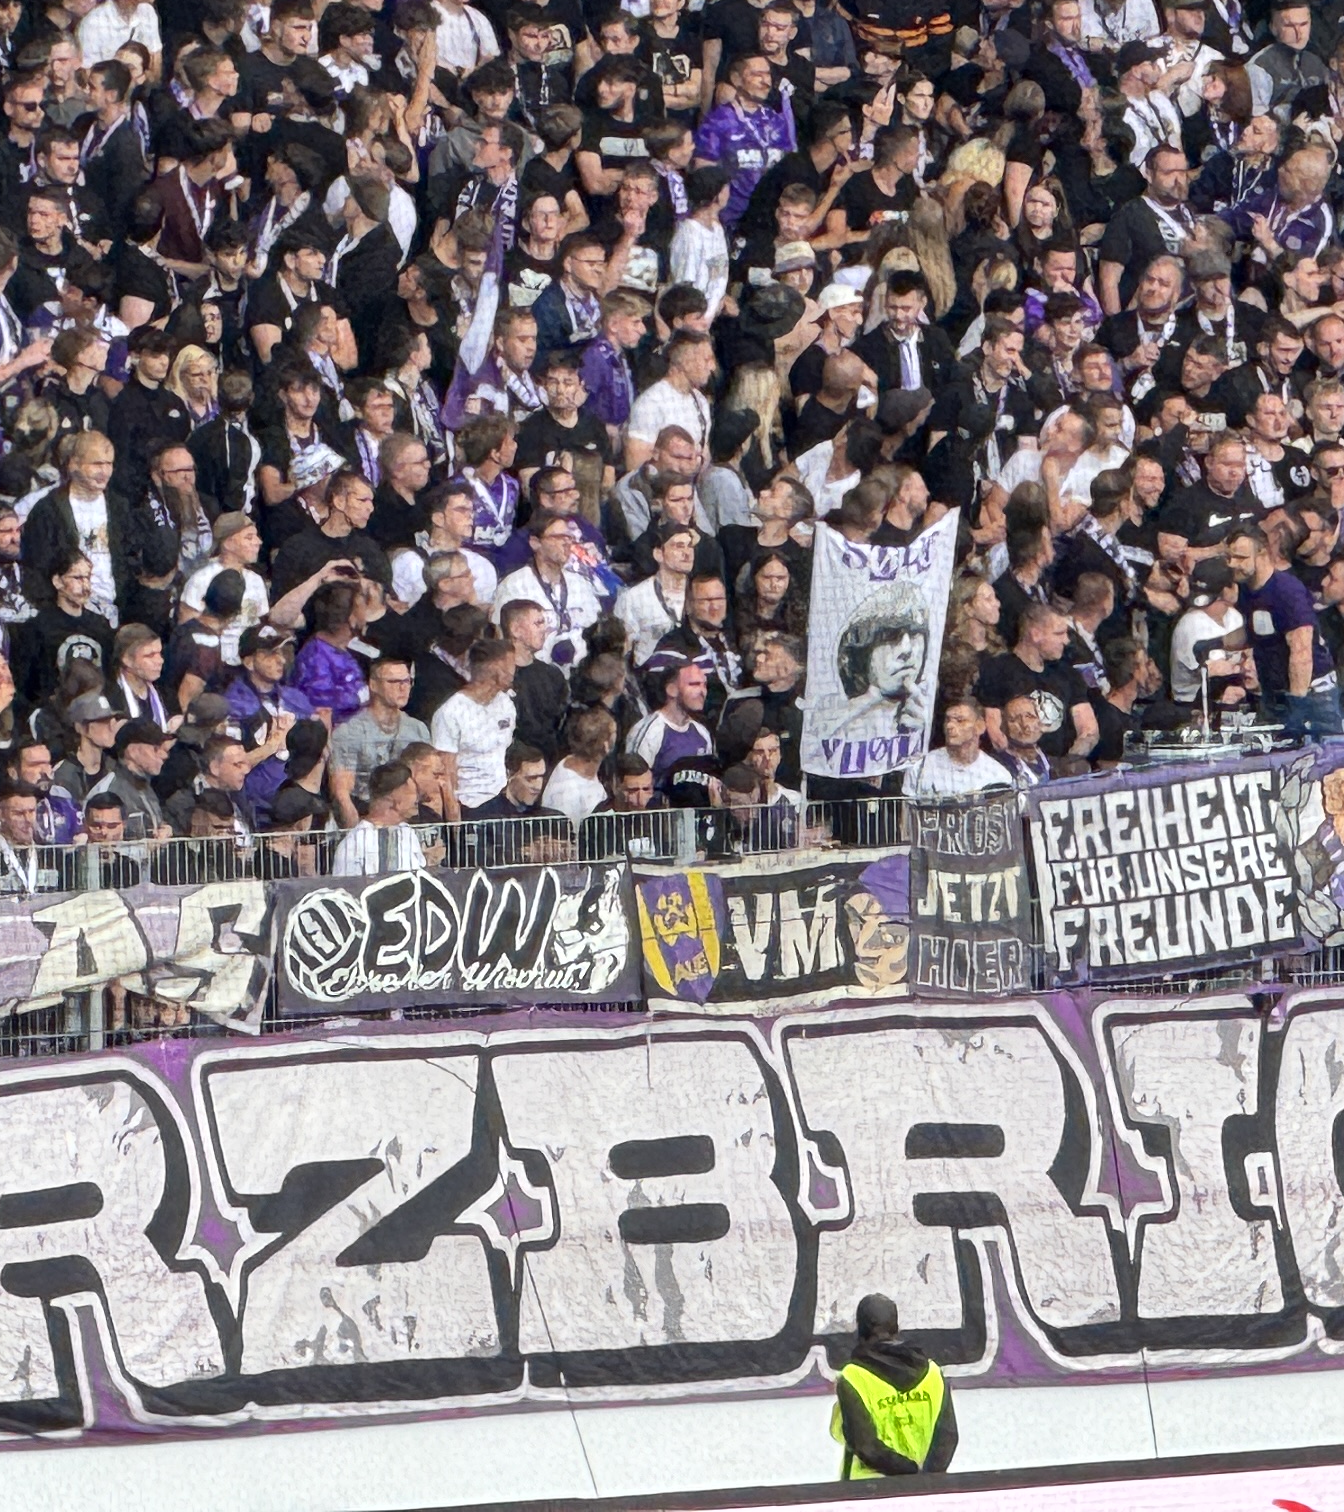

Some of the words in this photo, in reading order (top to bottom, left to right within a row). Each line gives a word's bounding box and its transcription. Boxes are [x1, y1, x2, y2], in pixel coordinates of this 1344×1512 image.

[1039, 770, 1282, 862] FREIHEIT
[916, 865, 1021, 923] JETZT
[1050, 856, 1125, 908] FÜR
[1128, 834, 1289, 901] UNSERE
[1053, 877, 1296, 972] FREUNDE
